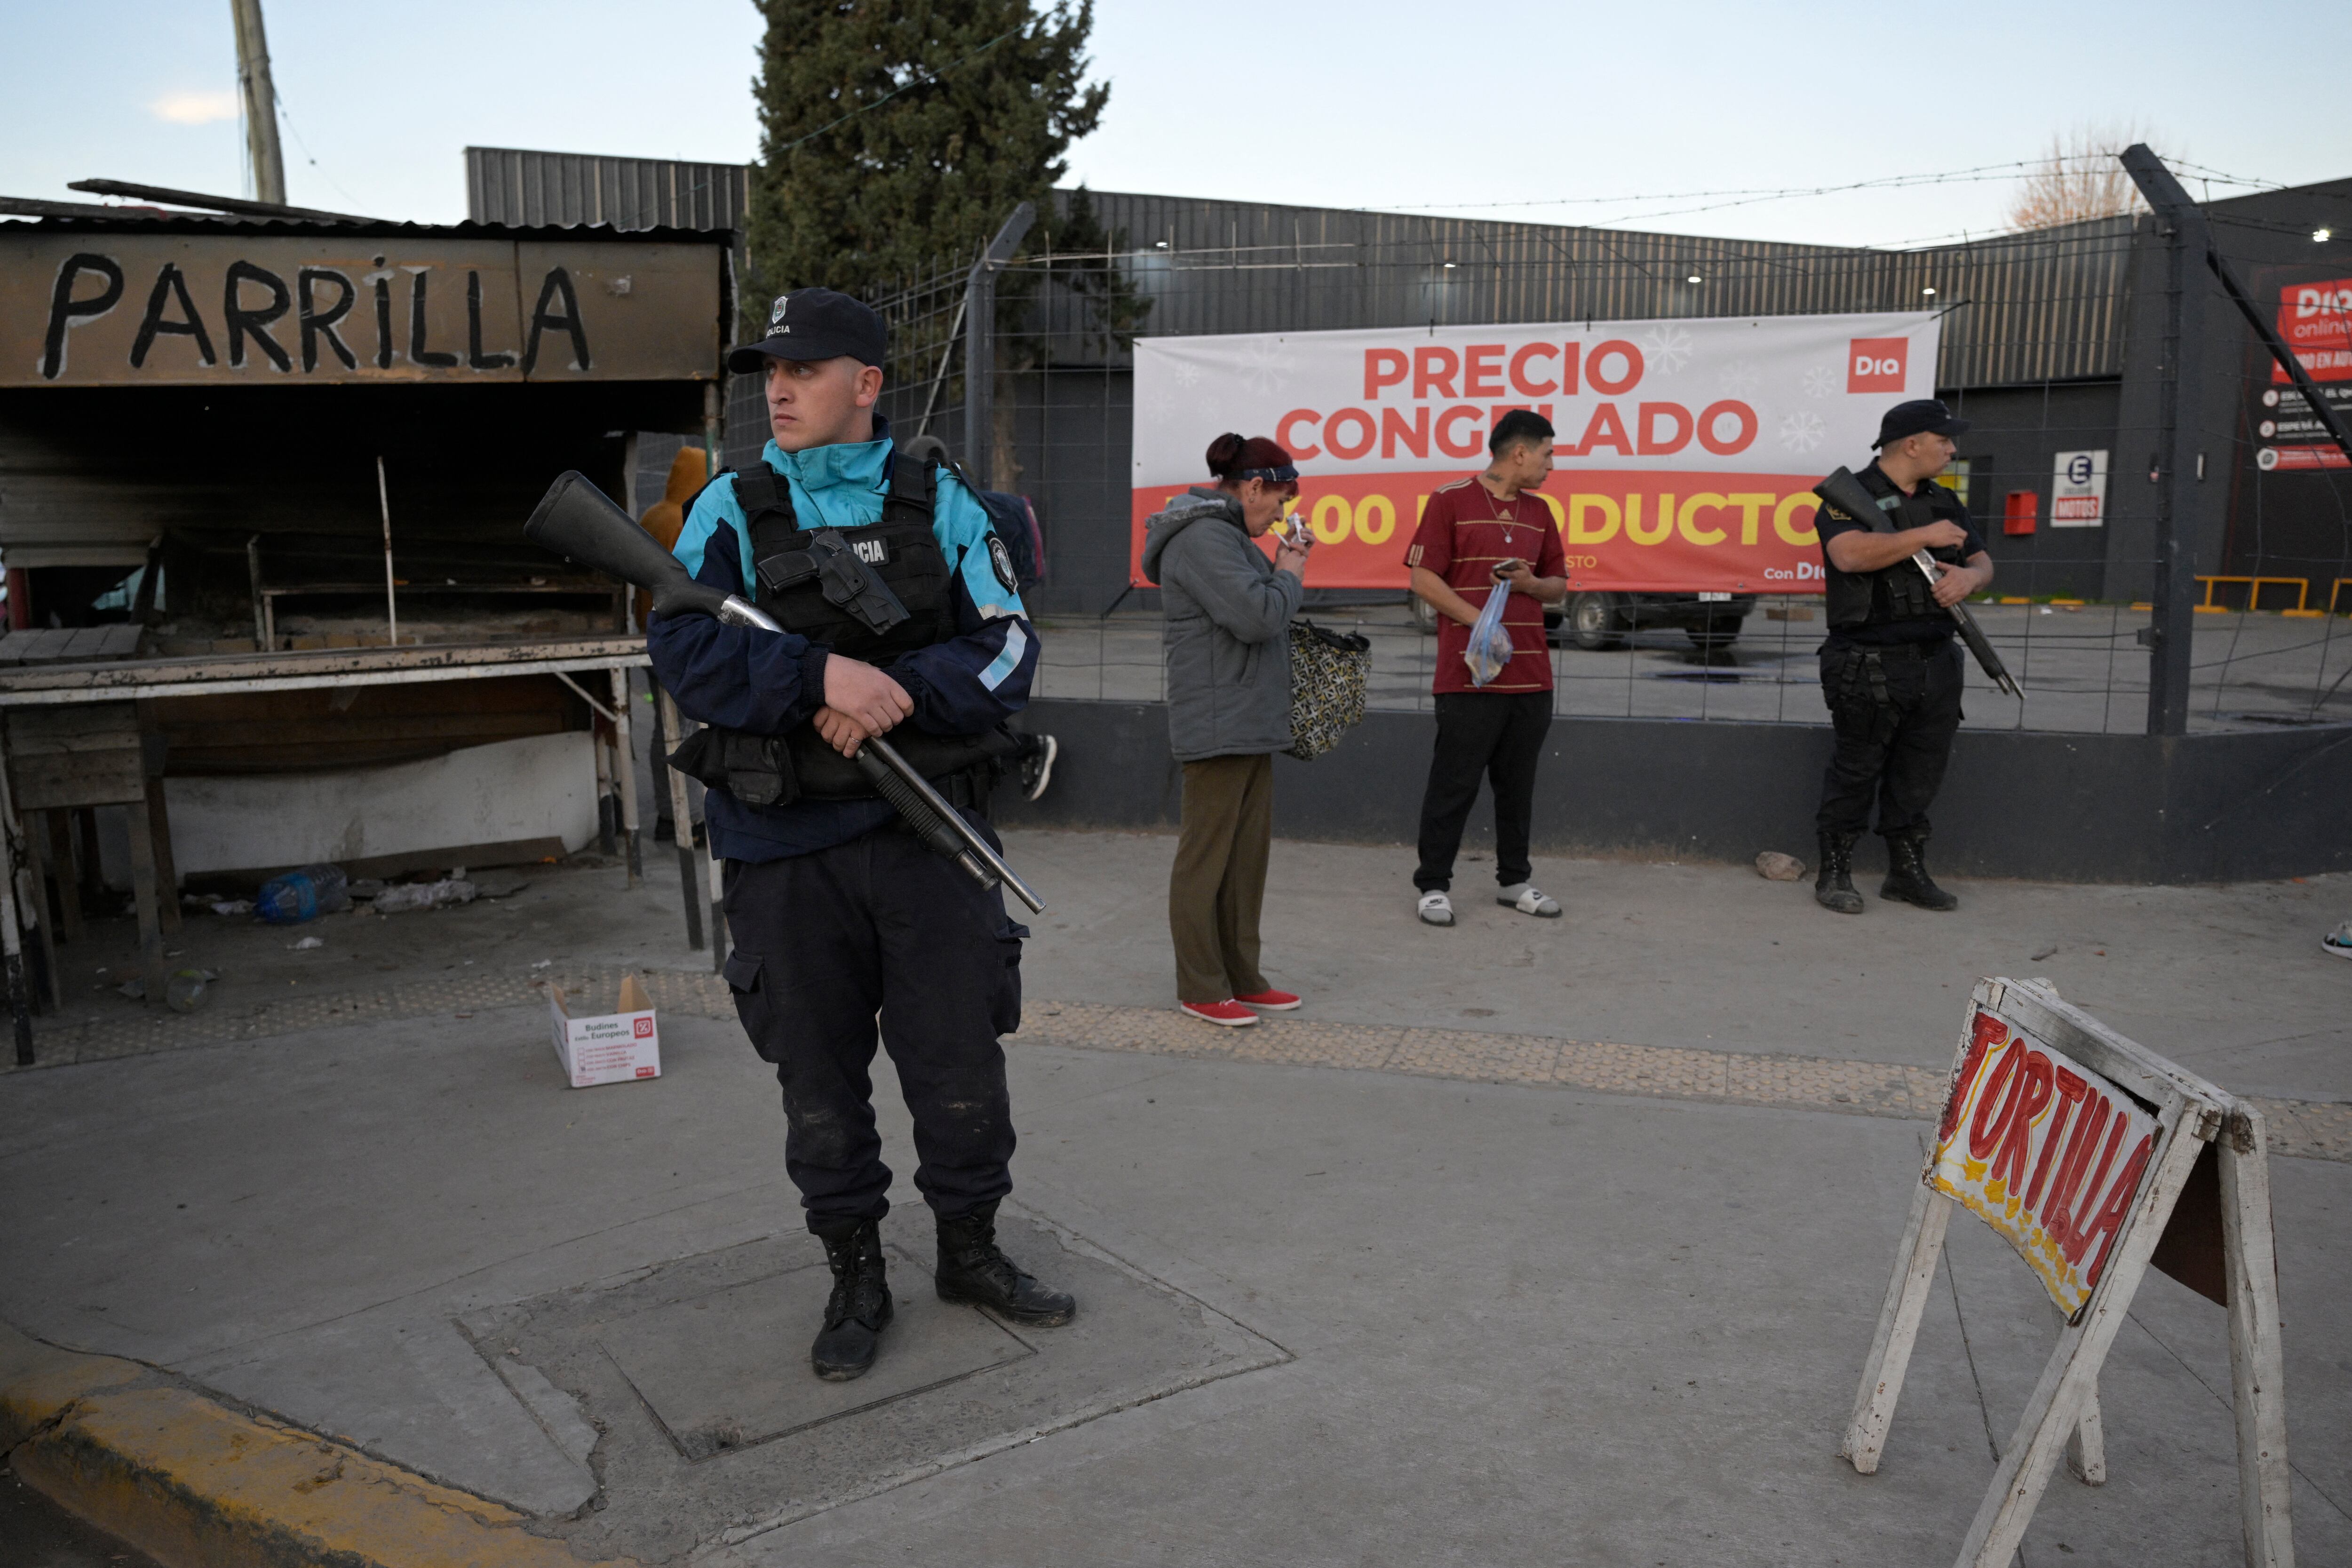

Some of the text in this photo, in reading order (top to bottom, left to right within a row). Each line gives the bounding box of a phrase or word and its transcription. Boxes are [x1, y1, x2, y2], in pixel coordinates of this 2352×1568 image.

[1364, 339, 1645, 401] PRECIO
[1417, 492, 1824, 546] DUCTO
[1764, 568, 1793, 579] Con
[586, 1022, 618, 1031] Budines
[591, 1030, 629, 1039] Europeos
[1938, 1011, 2153, 1288] TORTILLA
